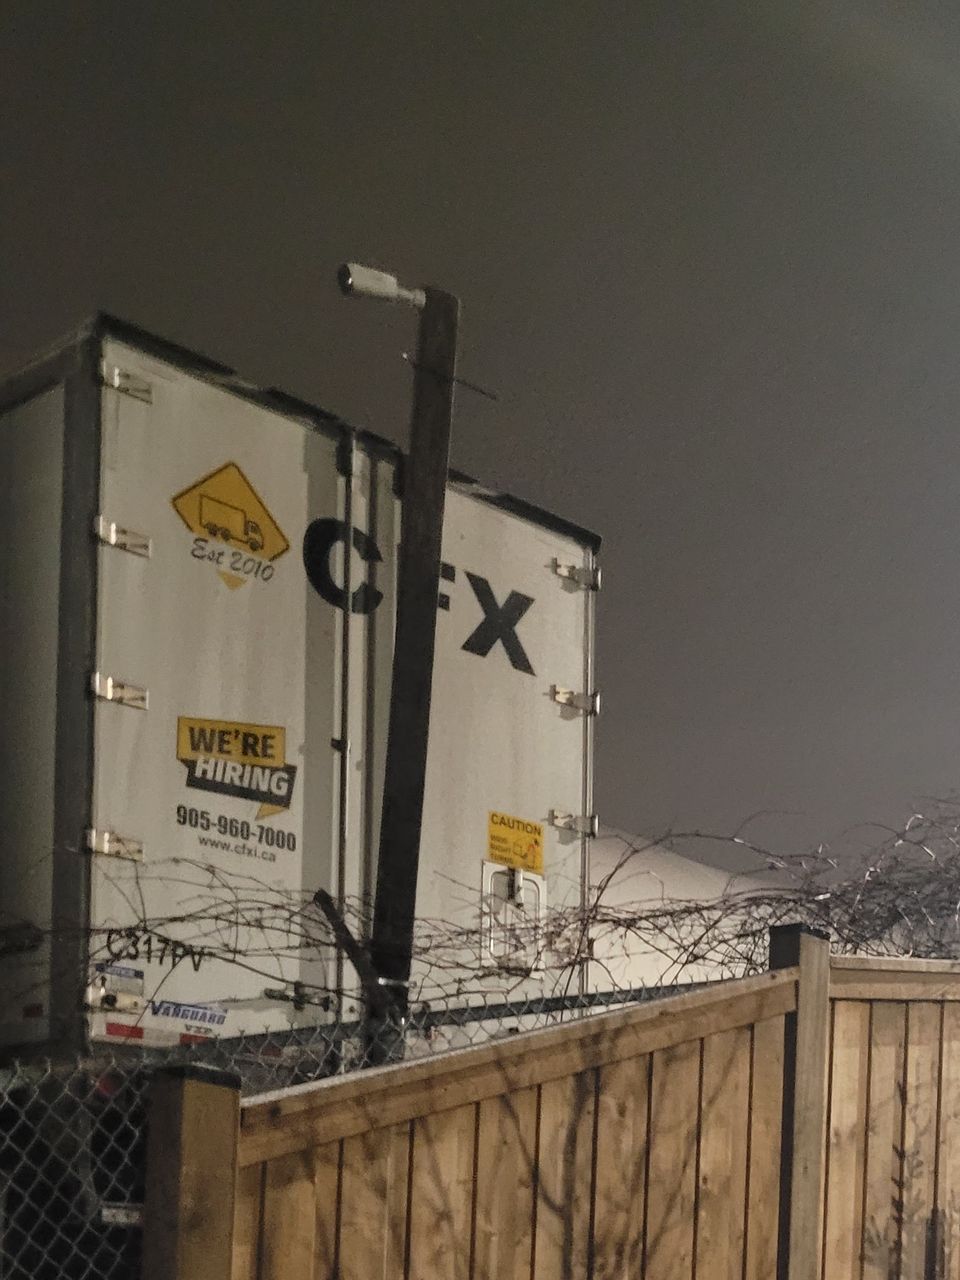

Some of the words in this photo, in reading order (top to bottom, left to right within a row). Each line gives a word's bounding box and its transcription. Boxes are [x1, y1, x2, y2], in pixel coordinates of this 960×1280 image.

[191, 538, 224, 565] Est
[230, 551, 275, 581] 2010
[303, 518, 537, 677] CX
[188, 726, 276, 759] WE'RE
[194, 756, 289, 796] HIRING
[176, 804, 297, 852] 905-960-7000
[491, 813, 542, 836] CAUTION
[198, 834, 277, 862] www.cfxi.ca
[150, 999, 228, 1025] VANGUARD
